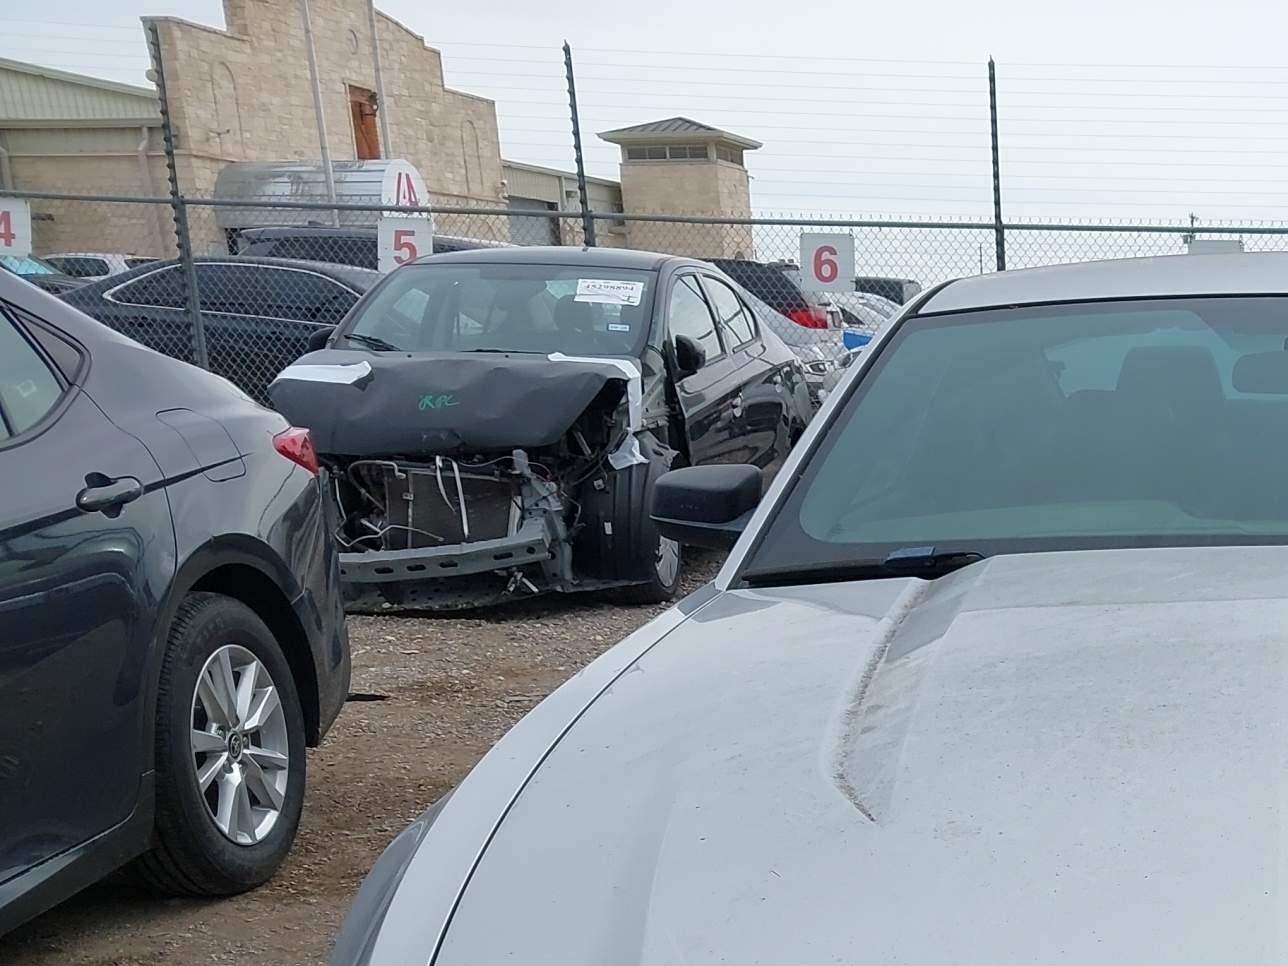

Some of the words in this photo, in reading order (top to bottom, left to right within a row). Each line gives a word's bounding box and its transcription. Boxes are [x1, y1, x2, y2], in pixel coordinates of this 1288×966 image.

[0, 210, 16, 247] 4
[393, 229, 418, 266] 5
[813, 245, 839, 283] 6
